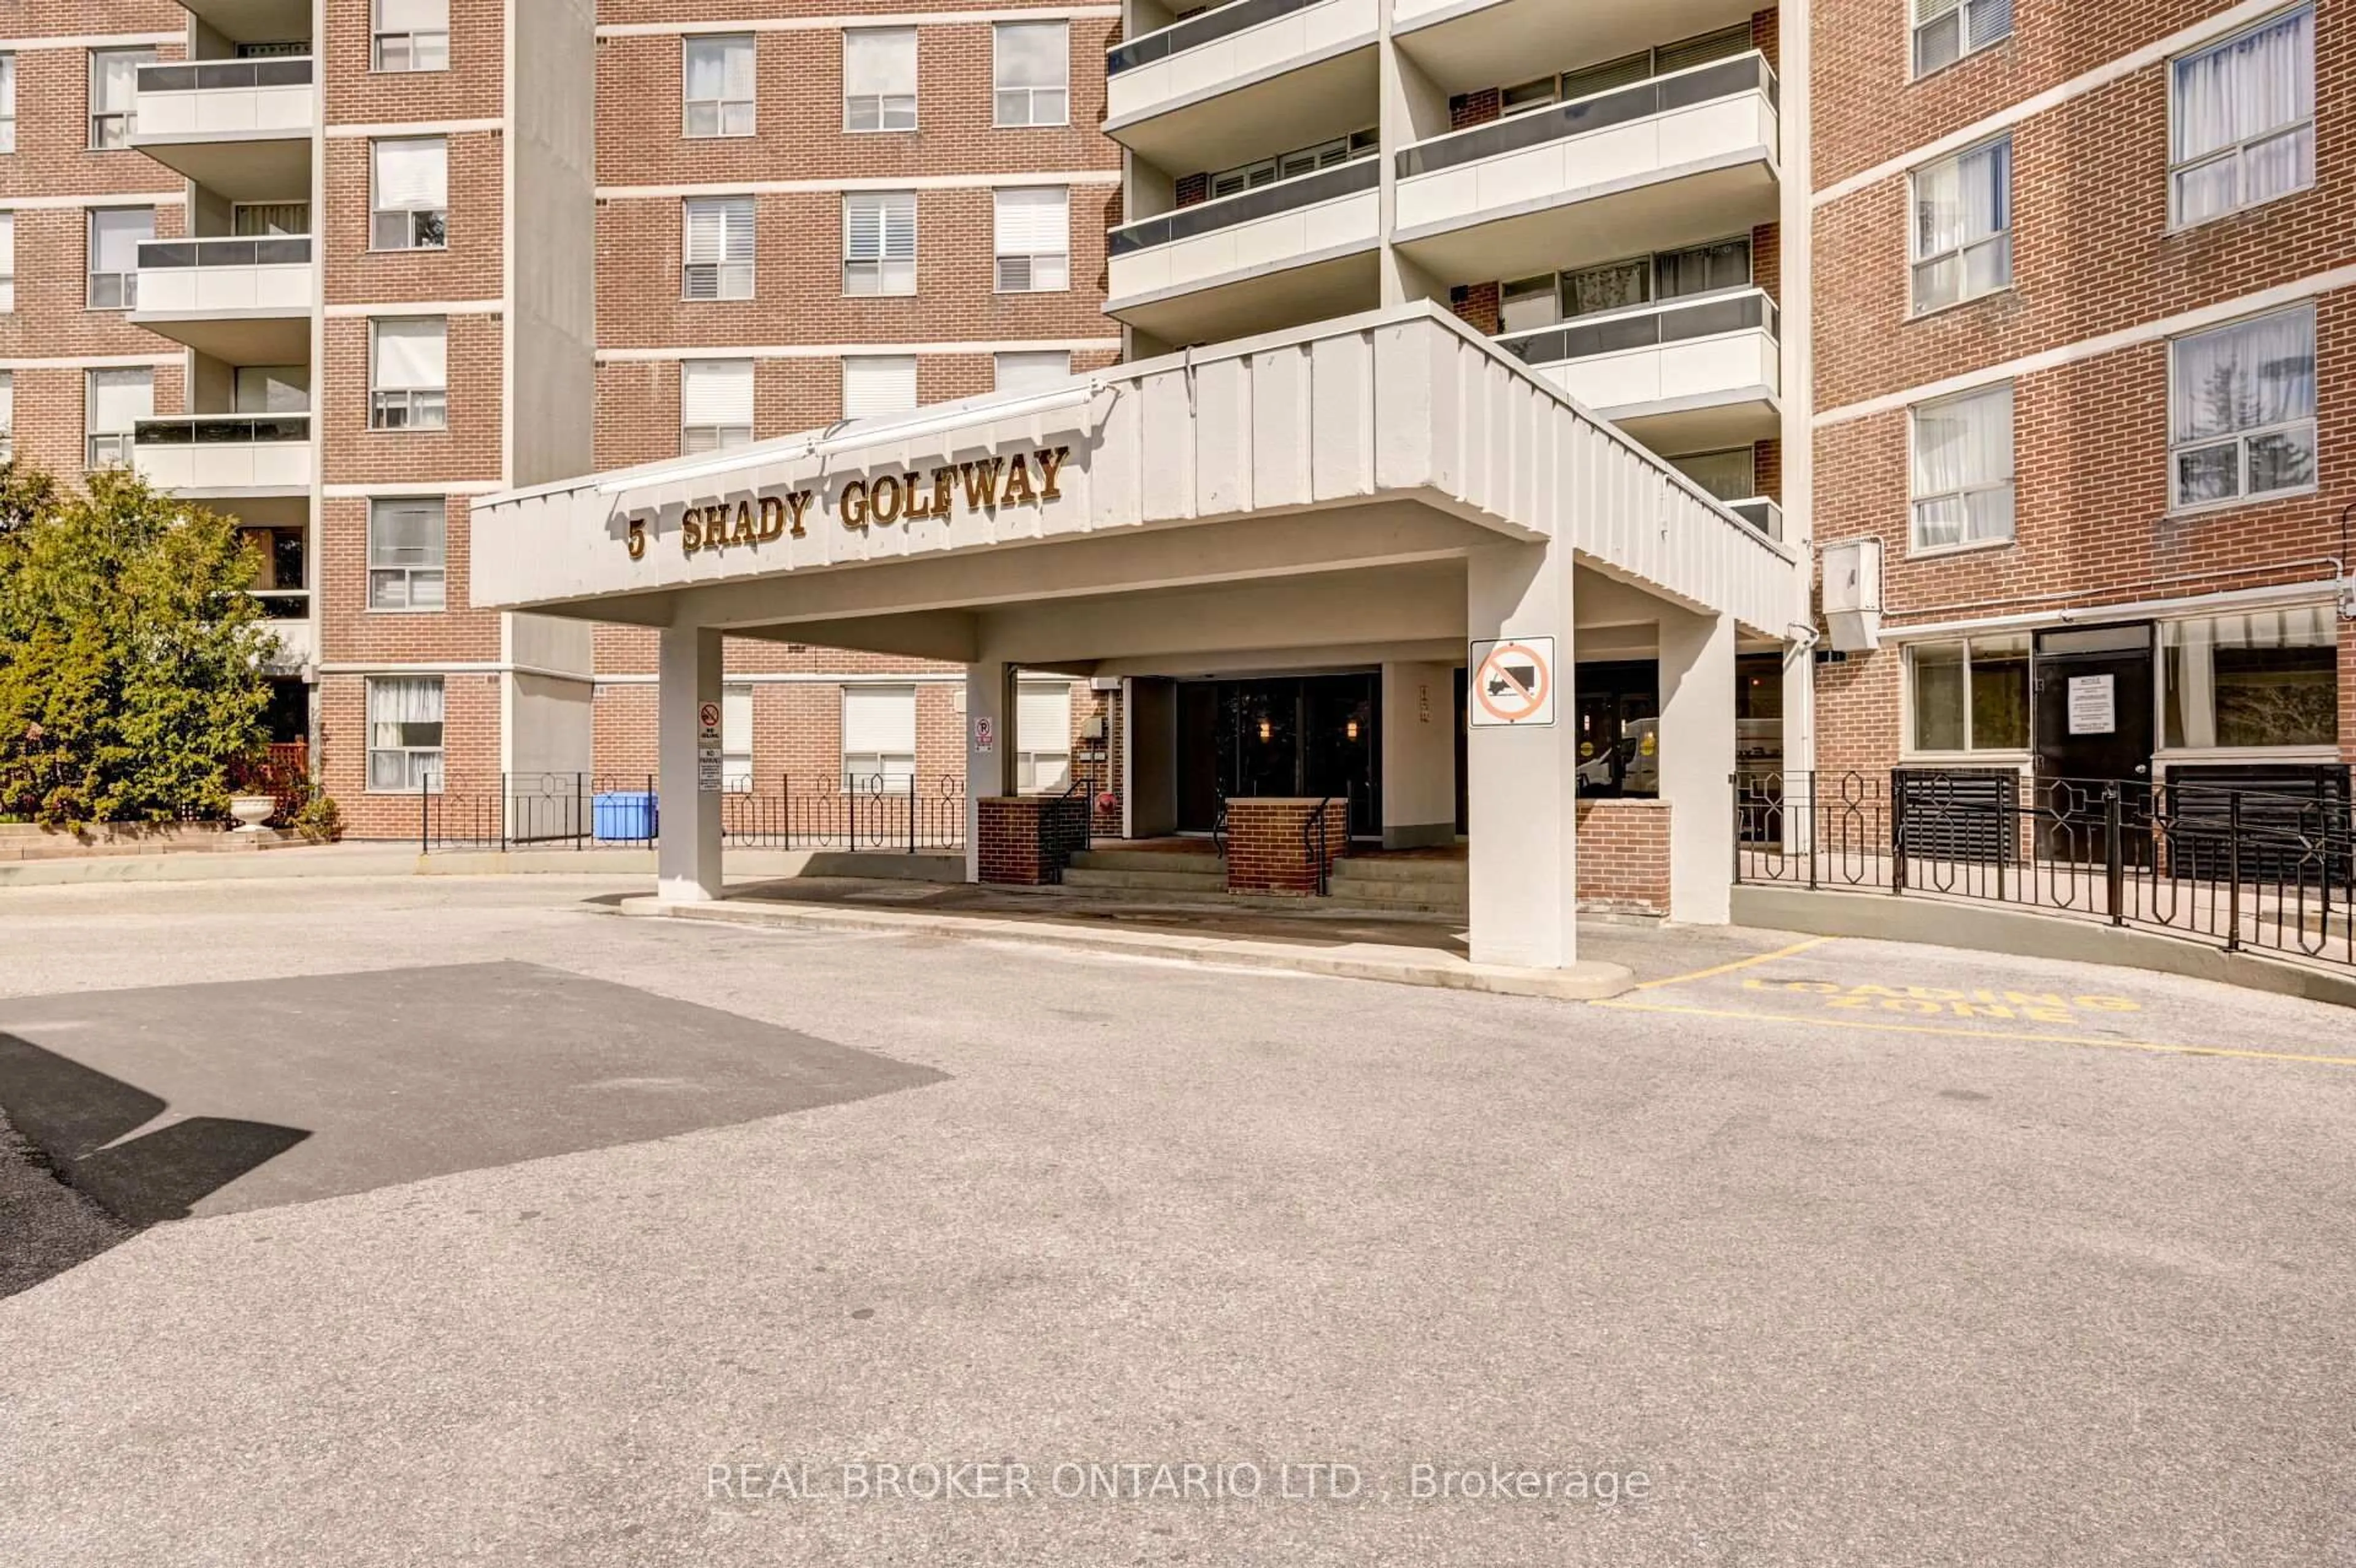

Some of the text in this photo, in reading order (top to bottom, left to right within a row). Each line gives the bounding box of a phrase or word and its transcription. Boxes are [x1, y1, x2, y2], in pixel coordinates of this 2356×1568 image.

[628, 445, 1069, 559] 5 SHADY GOLFWAY
[1743, 979, 2141, 1012] LOADING
[1825, 995, 2079, 1025] ZONE
